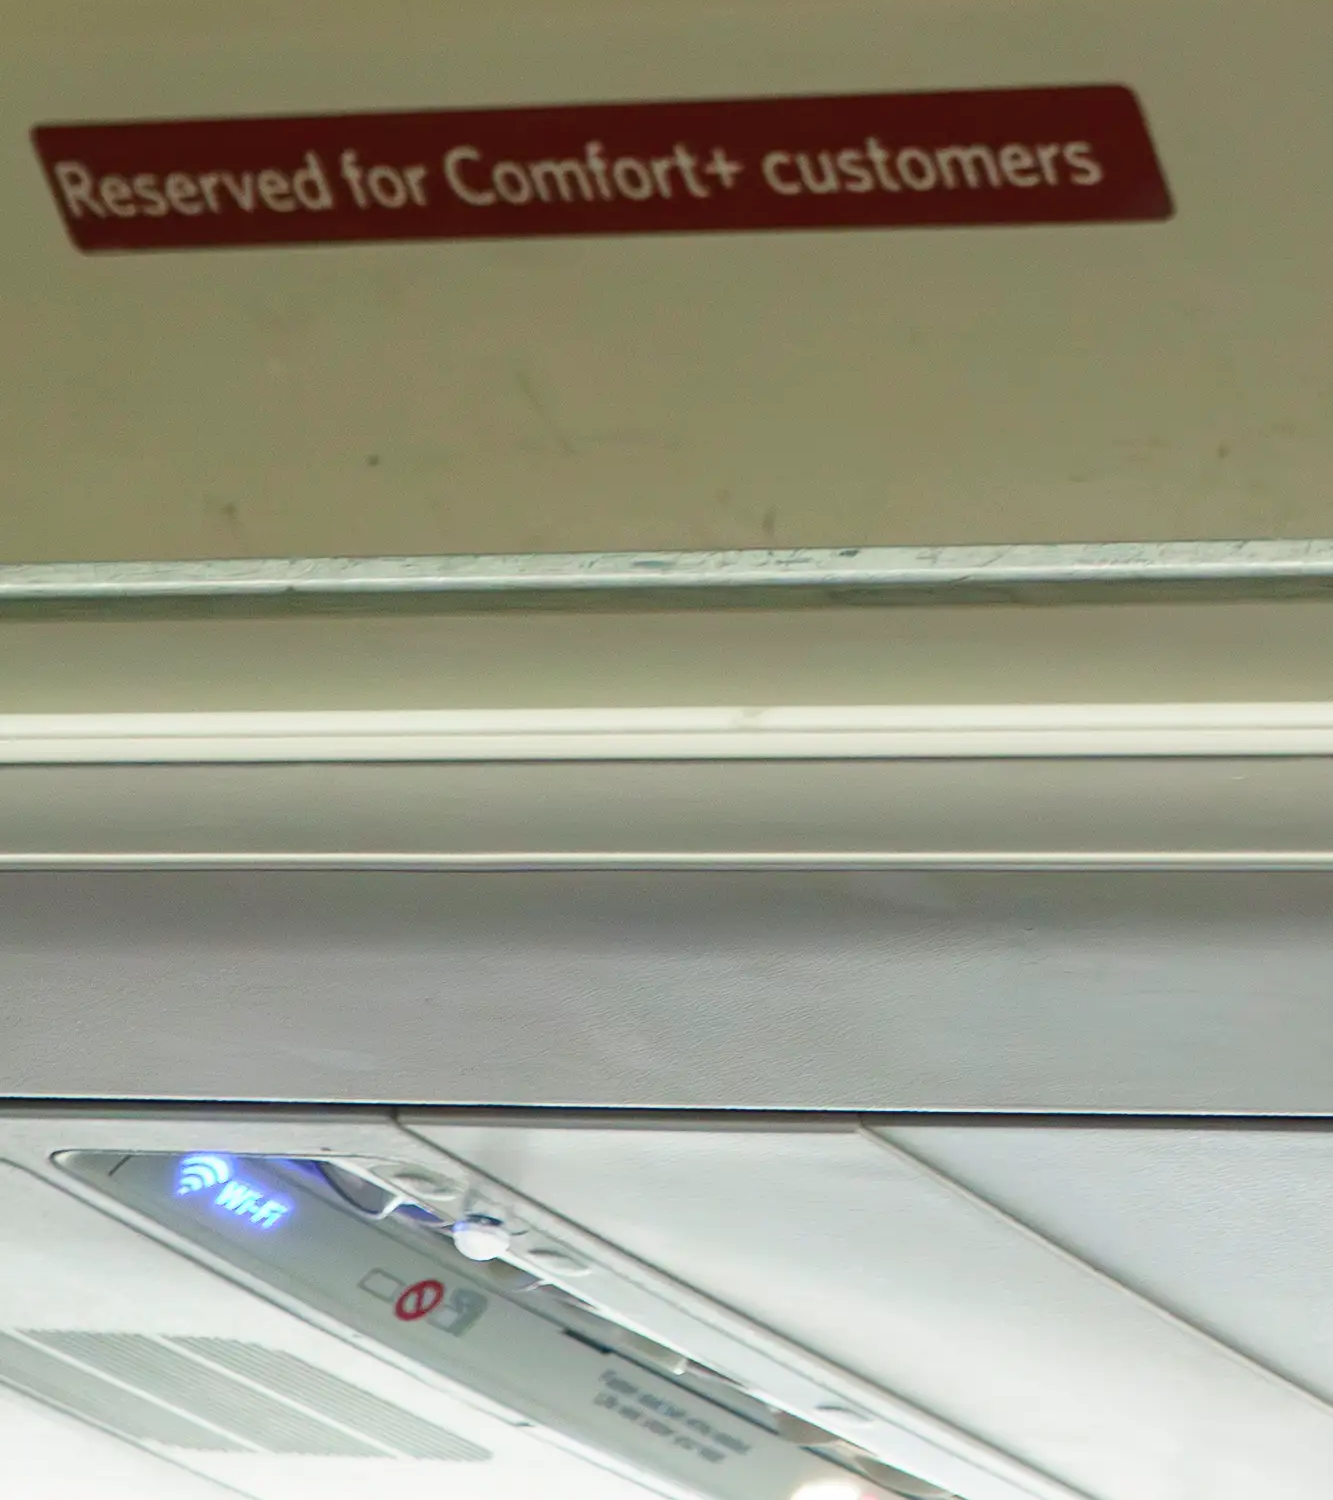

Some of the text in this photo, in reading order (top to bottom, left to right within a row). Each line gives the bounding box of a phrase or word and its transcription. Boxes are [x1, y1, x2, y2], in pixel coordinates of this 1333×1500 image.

[55, 134, 1103, 222] Reserved for Comfort+ customers
[214, 1180, 289, 1229] Wi-Fi
